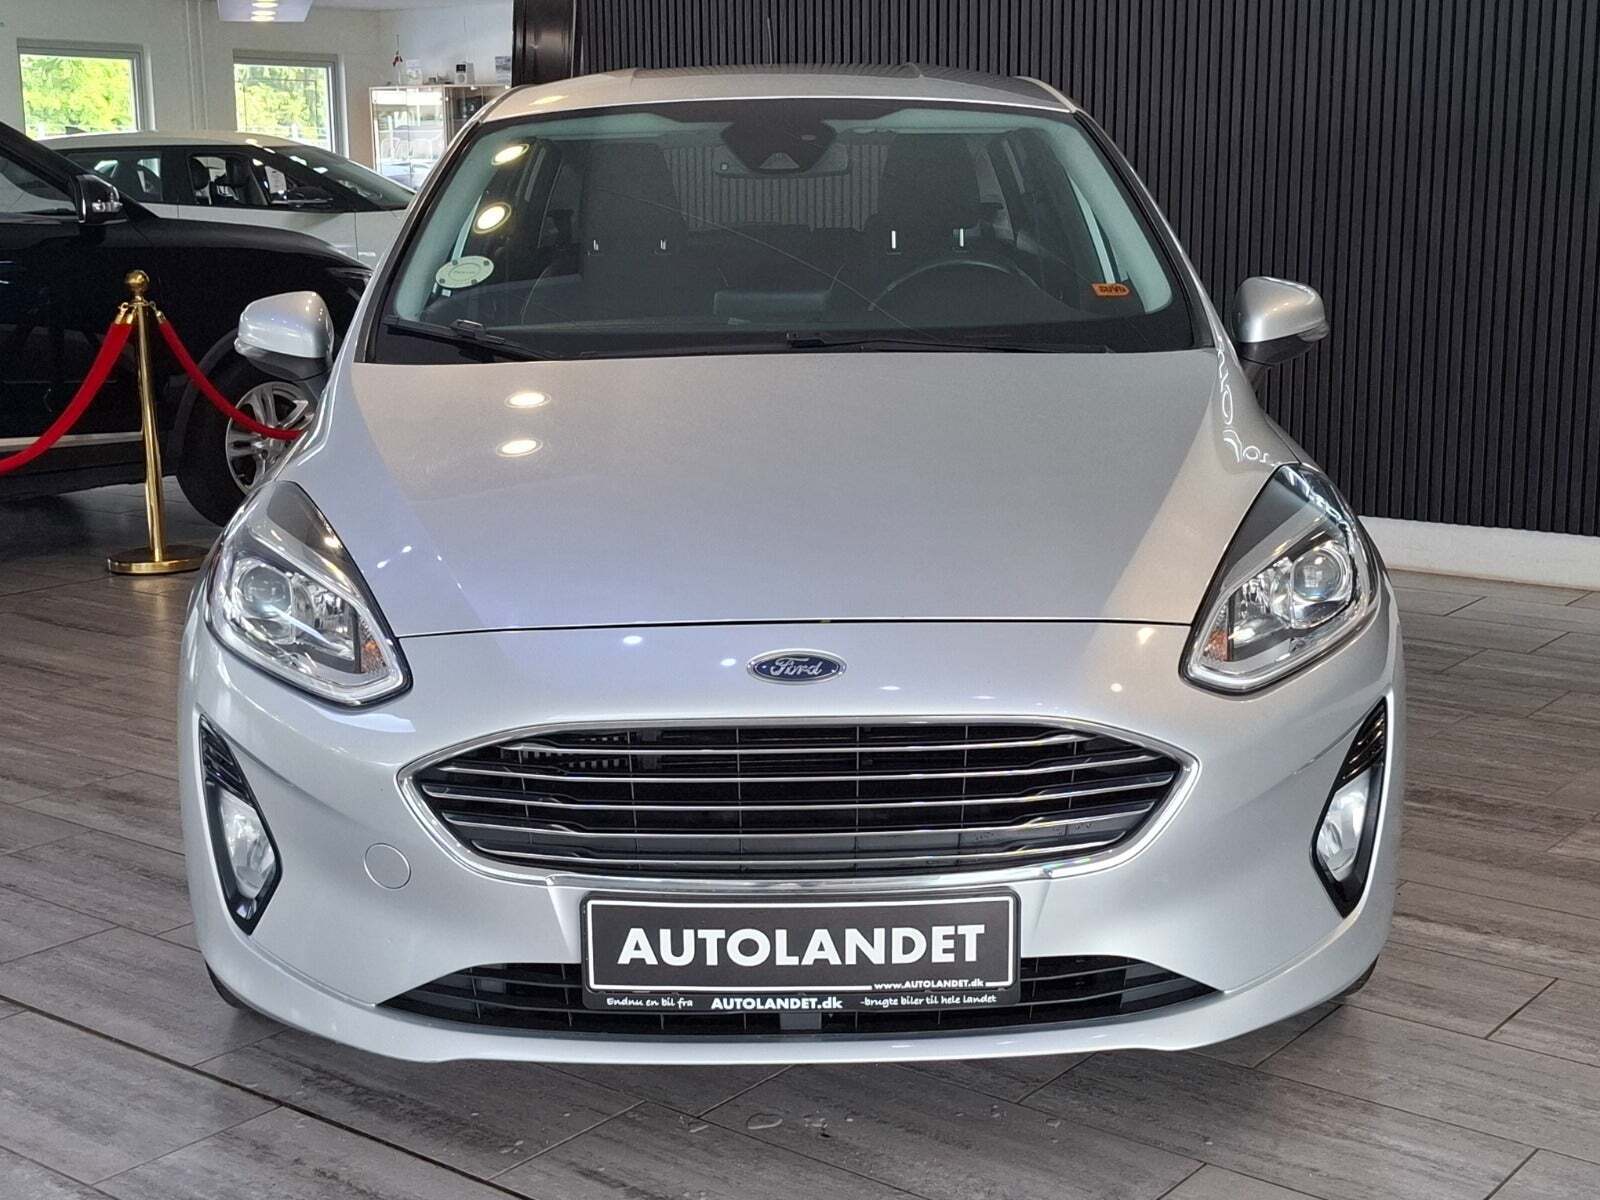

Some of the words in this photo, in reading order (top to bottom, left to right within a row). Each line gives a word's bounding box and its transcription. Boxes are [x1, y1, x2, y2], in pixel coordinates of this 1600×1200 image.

[770, 657, 823, 676] Ford
[617, 924, 985, 967] AUTOLANDET
[874, 978, 984, 990] www.AUTOLANDET.dk
[606, 997, 643, 1006] Endnu
[645, 999, 659, 1007] en
[661, 997, 675, 1007] bil
[677, 997, 693, 1009] fra
[710, 996, 843, 1010] AUTOLANDET.dk
[900, 996, 923, 1006] biler
[925, 995, 938, 1004] til
[941, 995, 961, 1004] hele
[963, 994, 997, 1004] landet
